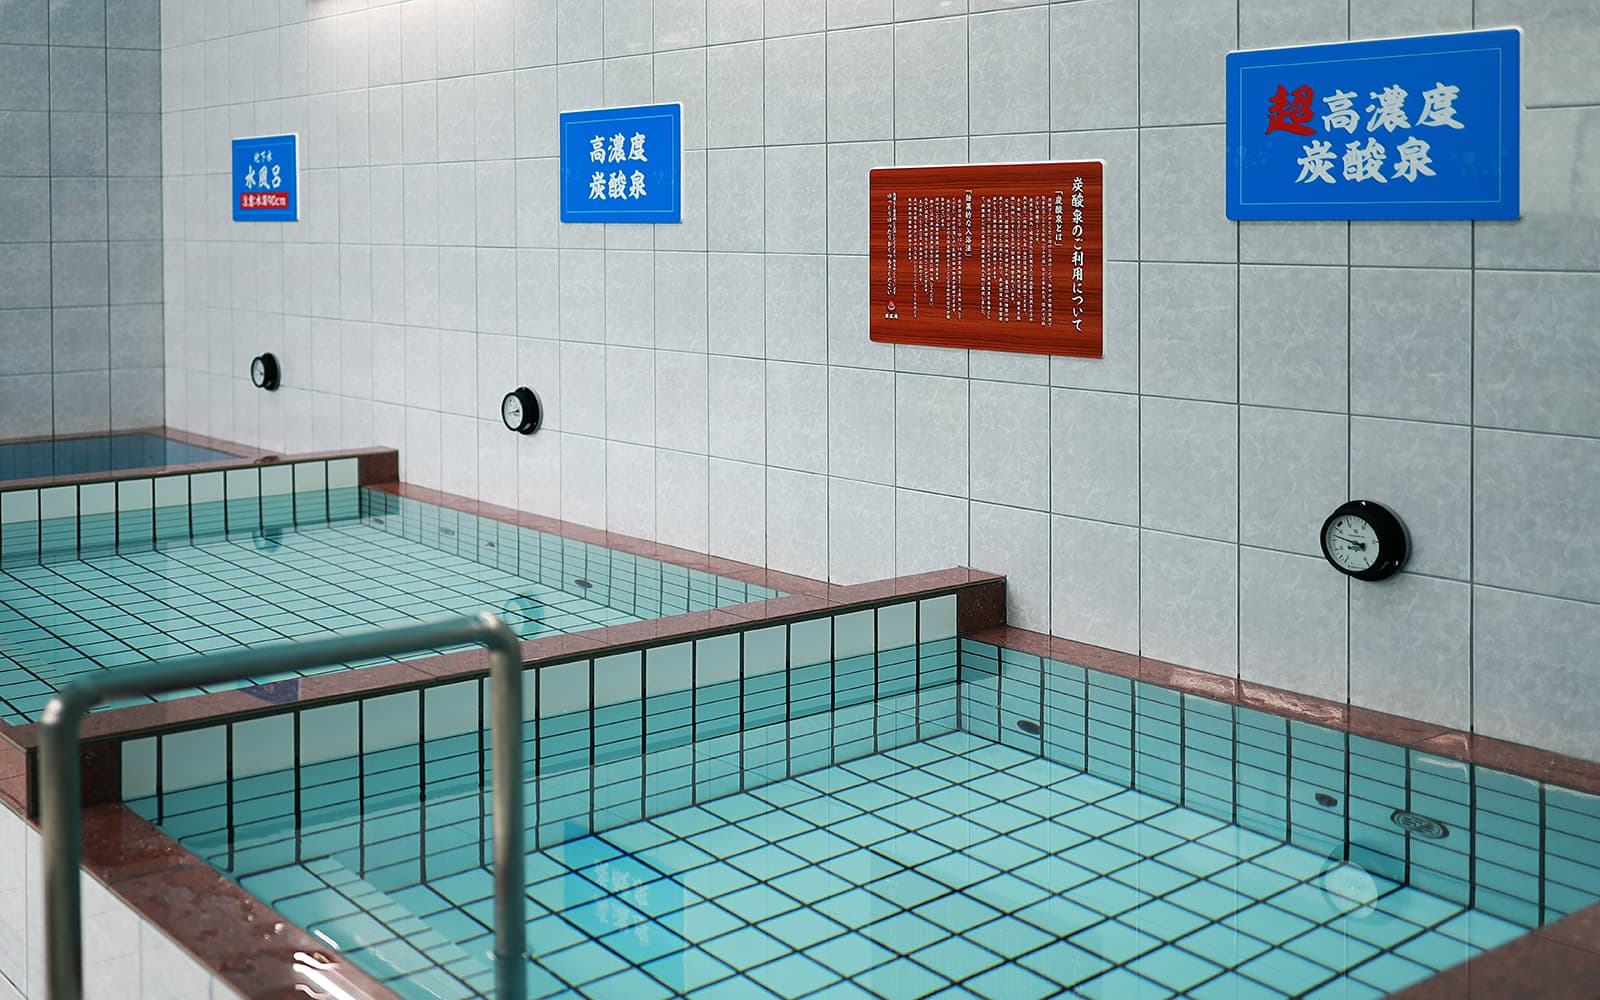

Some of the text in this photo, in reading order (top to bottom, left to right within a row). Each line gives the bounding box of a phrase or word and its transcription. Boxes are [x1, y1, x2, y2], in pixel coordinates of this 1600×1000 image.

[1266, 82, 1465, 137] 超高濃度
[589, 131, 648, 164] 高濃度
[1295, 136, 1437, 184] 炭酸泉
[245, 164, 281, 190] 水風呂
[588, 169, 648, 200] 炭酸泉
[1071, 176, 1085, 332] 炭酸泉のご利用について
